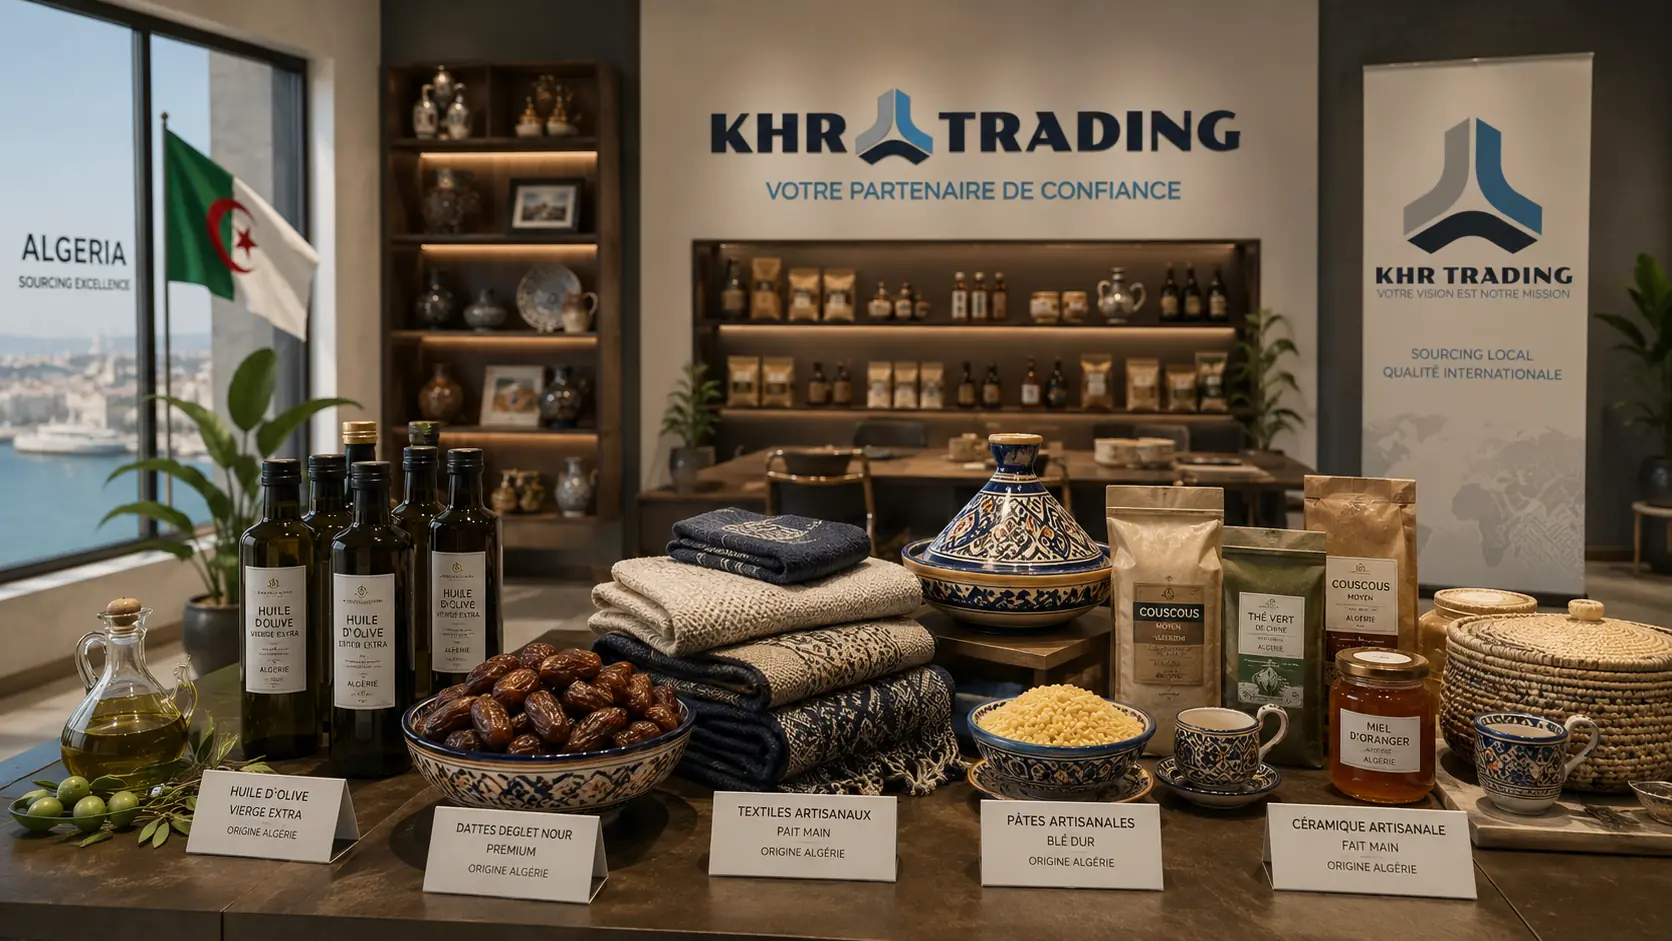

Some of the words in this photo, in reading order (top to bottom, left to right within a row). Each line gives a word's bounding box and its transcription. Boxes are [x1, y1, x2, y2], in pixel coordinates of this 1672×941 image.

[710, 111, 847, 154] KHR
[938, 109, 1241, 153] TRADING
[766, 180, 842, 201] VOTRE
[850, 180, 995, 201] PARTENAIRE
[1002, 181, 1034, 201] DE
[1041, 181, 1182, 201] CONFIANCE
[22, 233, 127, 266] ALGERIA
[1375, 266, 1435, 285] KHR
[1443, 266, 1573, 285] TRADING
[18, 275, 72, 289] SOURCING
[75, 277, 130, 291] EXCELLENCE
[1377, 288, 1414, 299] VOTRE
[1416, 288, 1454, 299] VISION
[1457, 288, 1476, 299] EST
[1480, 288, 1519, 299] NOTRE
[1523, 288, 1571, 299] MISSION
[1411, 348, 1483, 361] SOURCING
[1487, 349, 1534, 361] LOCAL
[1383, 365, 1440, 379] QUALITÉ
[1444, 367, 1563, 381] INTERNATIONALE
[1332, 580, 1390, 591] COUSCOUS
[258, 606, 291, 616] HUILE
[1139, 607, 1200, 618] COUSCOUS
[347, 615, 378, 625] HUILE
[1269, 615, 1295, 624] VERT
[1367, 722, 1391, 733] MIEL
[230, 786, 262, 799] HUILE
[229, 805, 265, 817] VIERGE
[268, 808, 302, 820] EXTRA
[738, 806, 792, 818] TEXTILES
[795, 808, 871, 821] ARTISANAUX
[1007, 812, 1046, 827] PÂTES
[1049, 816, 1135, 829] ARTISANALES
[1292, 816, 1366, 833] CÉRAMIQUE
[1369, 821, 1446, 836] ARTISANALE
[226, 825, 261, 837] ORIGINE
[456, 823, 496, 836] DATTES
[499, 825, 539, 838] DEGLET
[541, 829, 573, 840] NOUR
[803, 828, 831, 838] MAIN
[1047, 834, 1067, 846] BLÉ
[1071, 836, 1095, 847] DUR
[1342, 840, 1366, 851] FAIT
[1369, 841, 1399, 853] MAIN
[486, 844, 536, 857] PREMIUM
[760, 846, 802, 857] ORIGINE
[804, 847, 845, 858] ALGÉRIE
[1028, 856, 1070, 867] ORIGINE
[1072, 856, 1115, 868] ALGÉRIE
[1327, 860, 1370, 872] ORIGINE
[1373, 862, 1417, 874] ALGÉRIE
[468, 863, 507, 875] ORIGINE
[509, 865, 549, 879] ALGÉRIE
